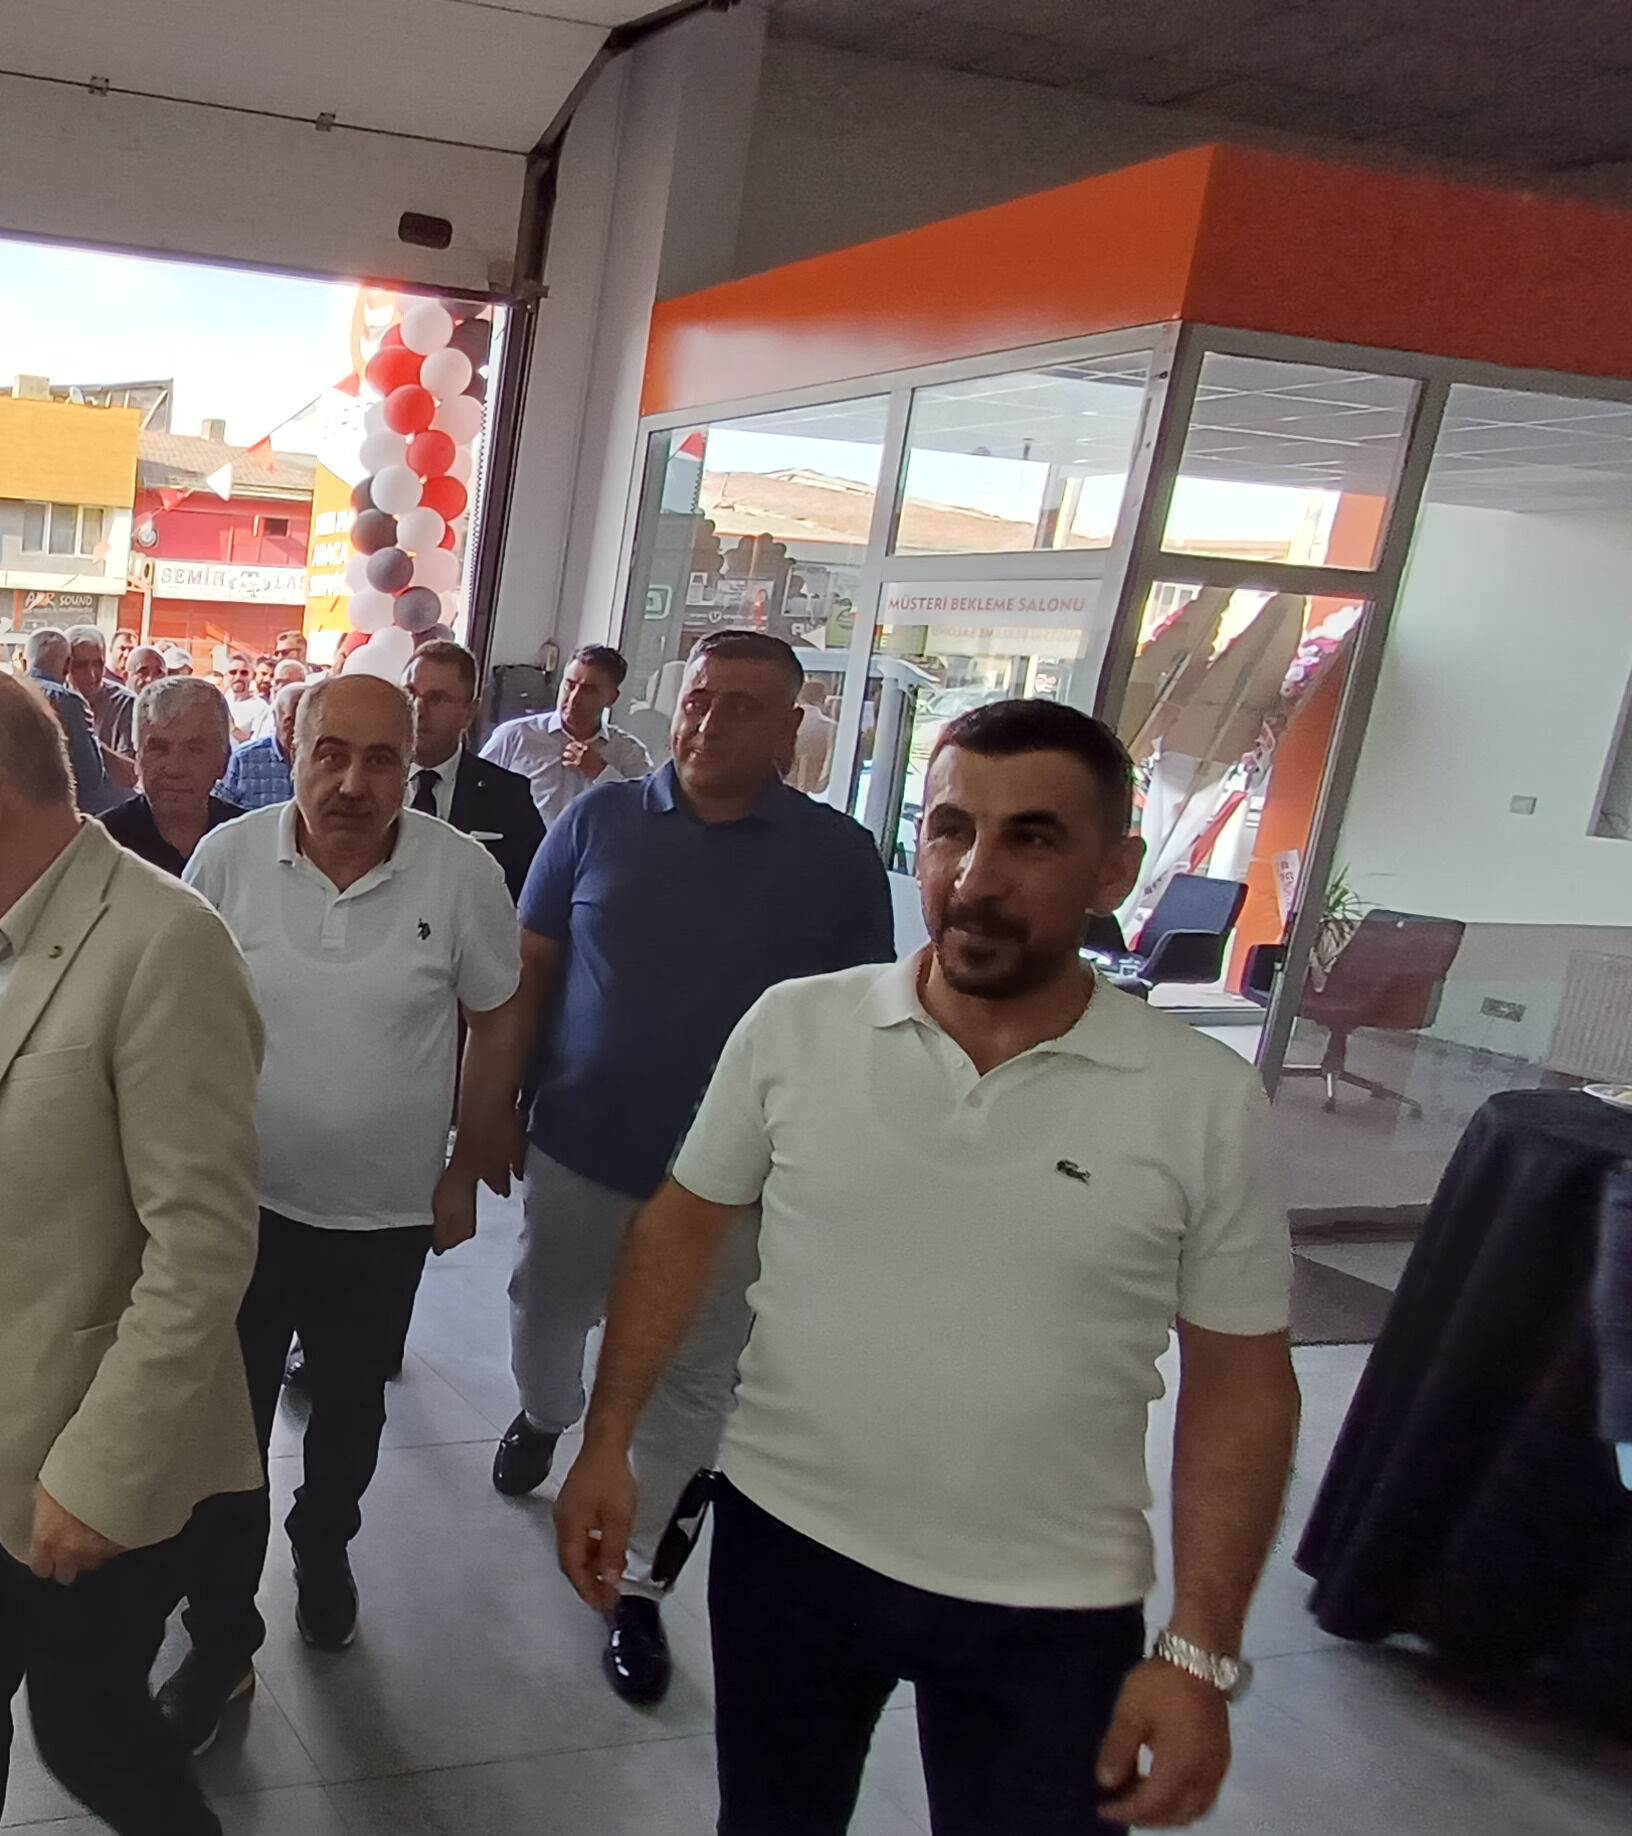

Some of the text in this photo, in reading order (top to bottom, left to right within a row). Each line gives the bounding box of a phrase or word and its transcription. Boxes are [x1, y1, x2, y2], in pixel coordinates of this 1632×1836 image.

[59, 594, 93, 607] SOUND
[951, 597, 1014, 612] BEKLEME
[1018, 597, 1086, 613] SALONU
